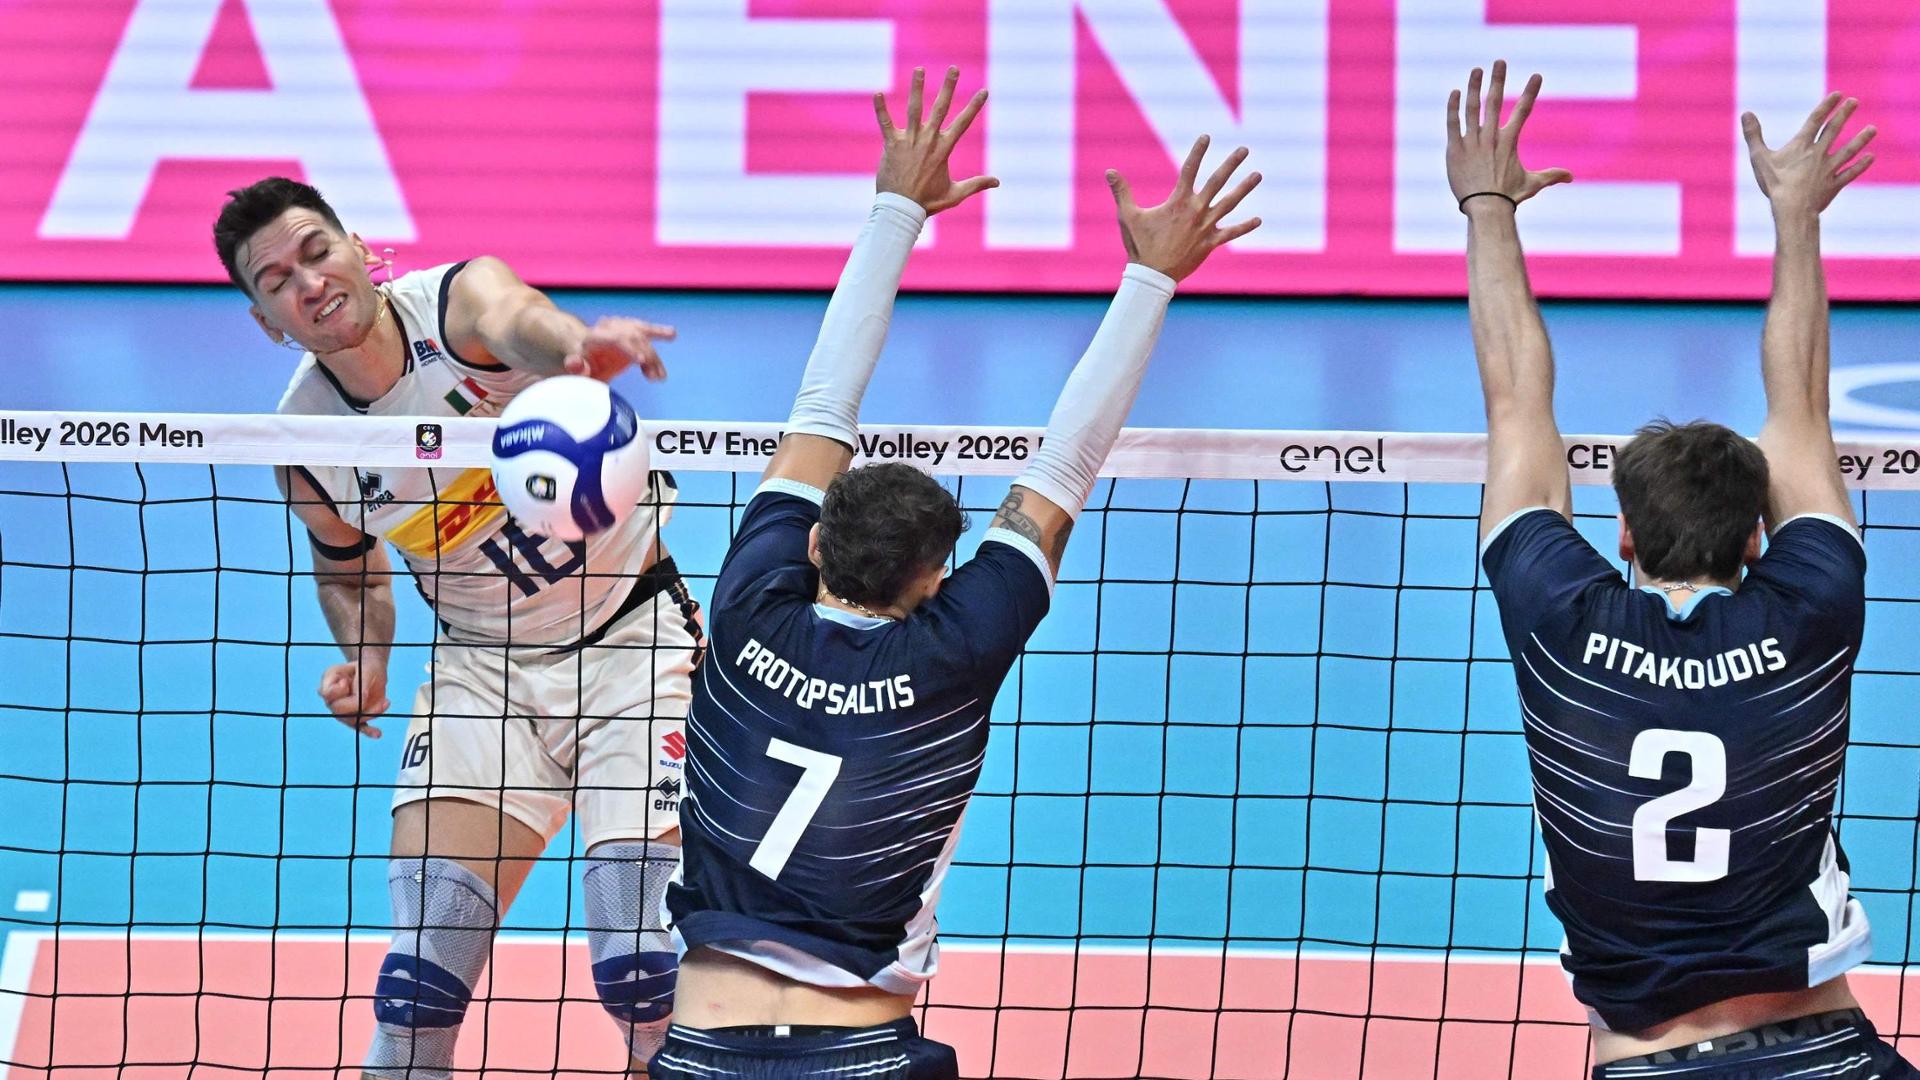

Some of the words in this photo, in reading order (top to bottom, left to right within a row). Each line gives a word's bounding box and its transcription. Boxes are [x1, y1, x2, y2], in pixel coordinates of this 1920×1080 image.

[59, 421, 130, 446] 2026
[139, 422, 204, 447] Men
[655, 430, 717, 454] CEV
[854, 433, 949, 465] Volley
[957, 435, 1029, 460] 2026
[1280, 437, 1386, 473] enel
[1582, 632, 1787, 690] PITAKOUDIS
[401, 731, 431, 770] 16
[749, 737, 843, 881] 7
[1628, 728, 1731, 882] 2
